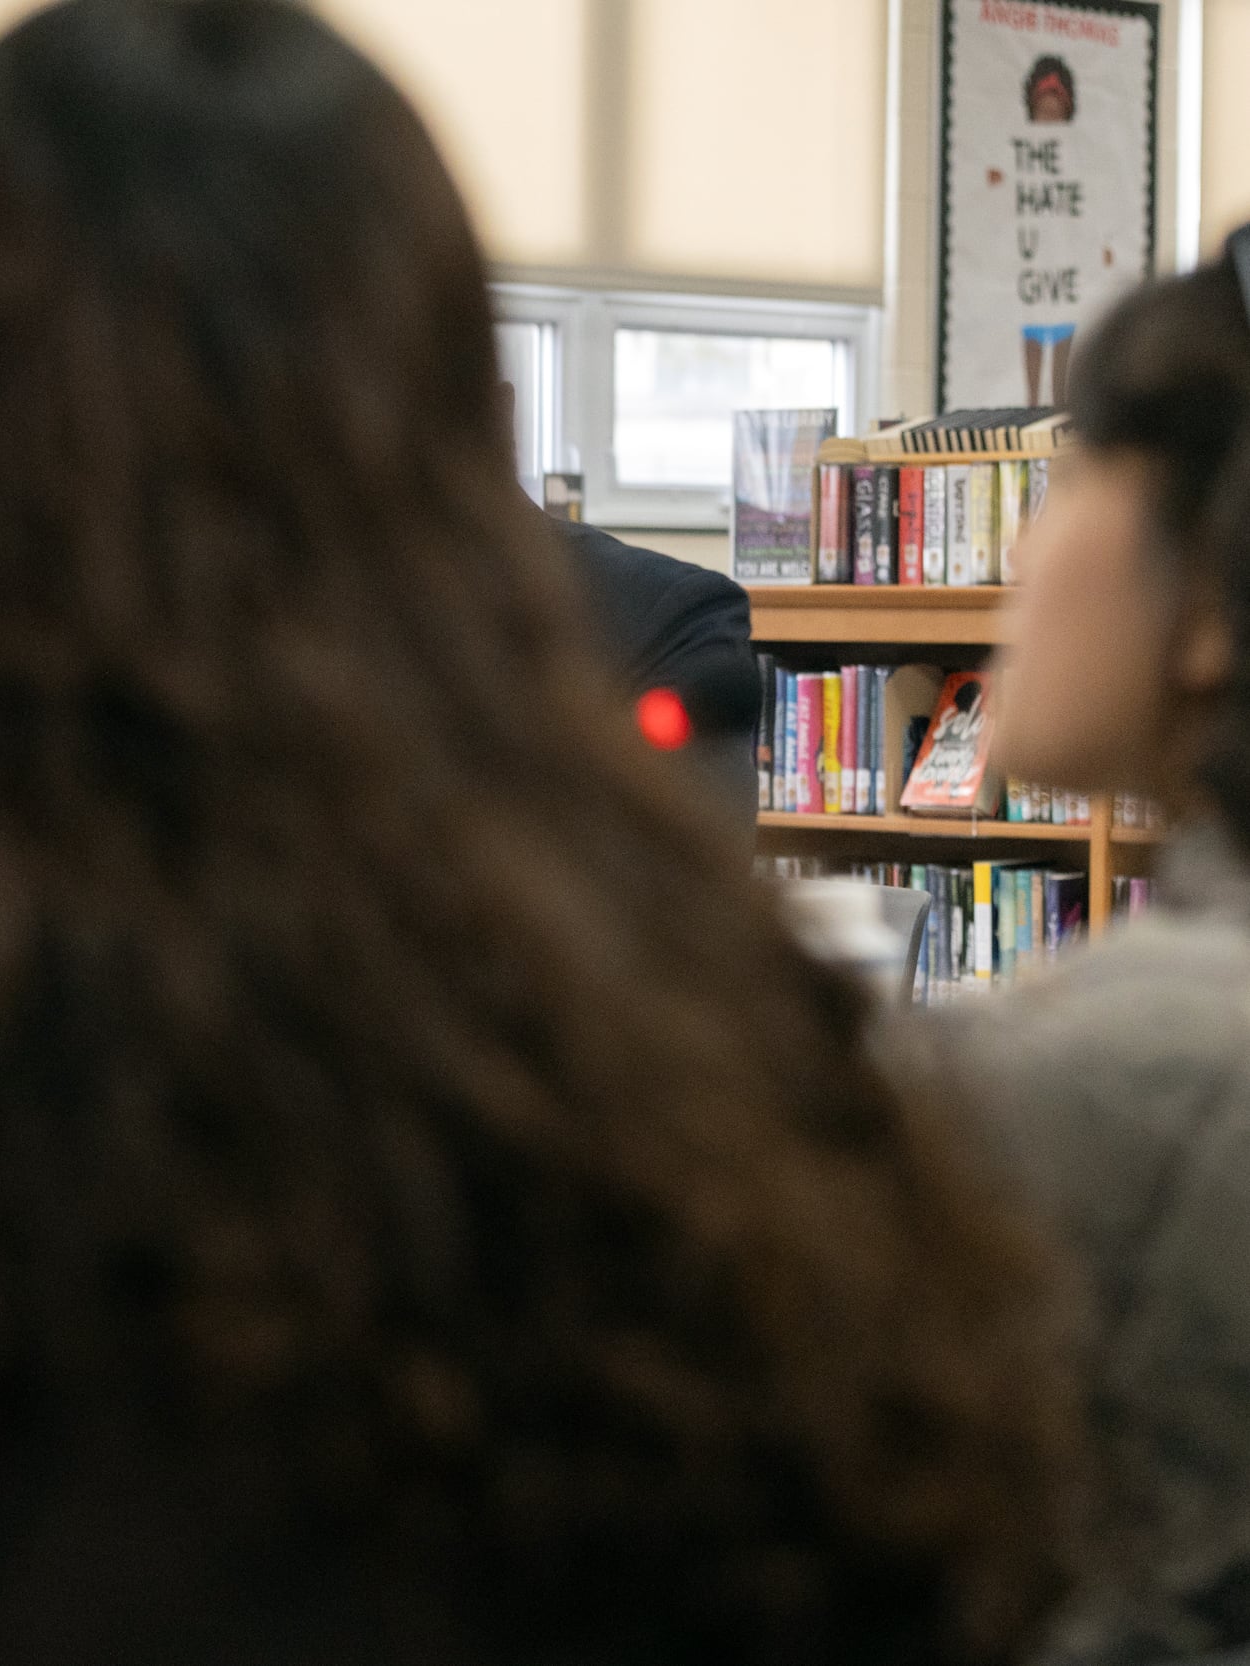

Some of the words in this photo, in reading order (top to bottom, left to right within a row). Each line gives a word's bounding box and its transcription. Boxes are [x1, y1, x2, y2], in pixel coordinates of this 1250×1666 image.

[1012, 138, 1060, 175] THE
[1014, 181, 1082, 218] HATE
[1017, 227, 1039, 260] U
[1016, 267, 1079, 304] GIVE
